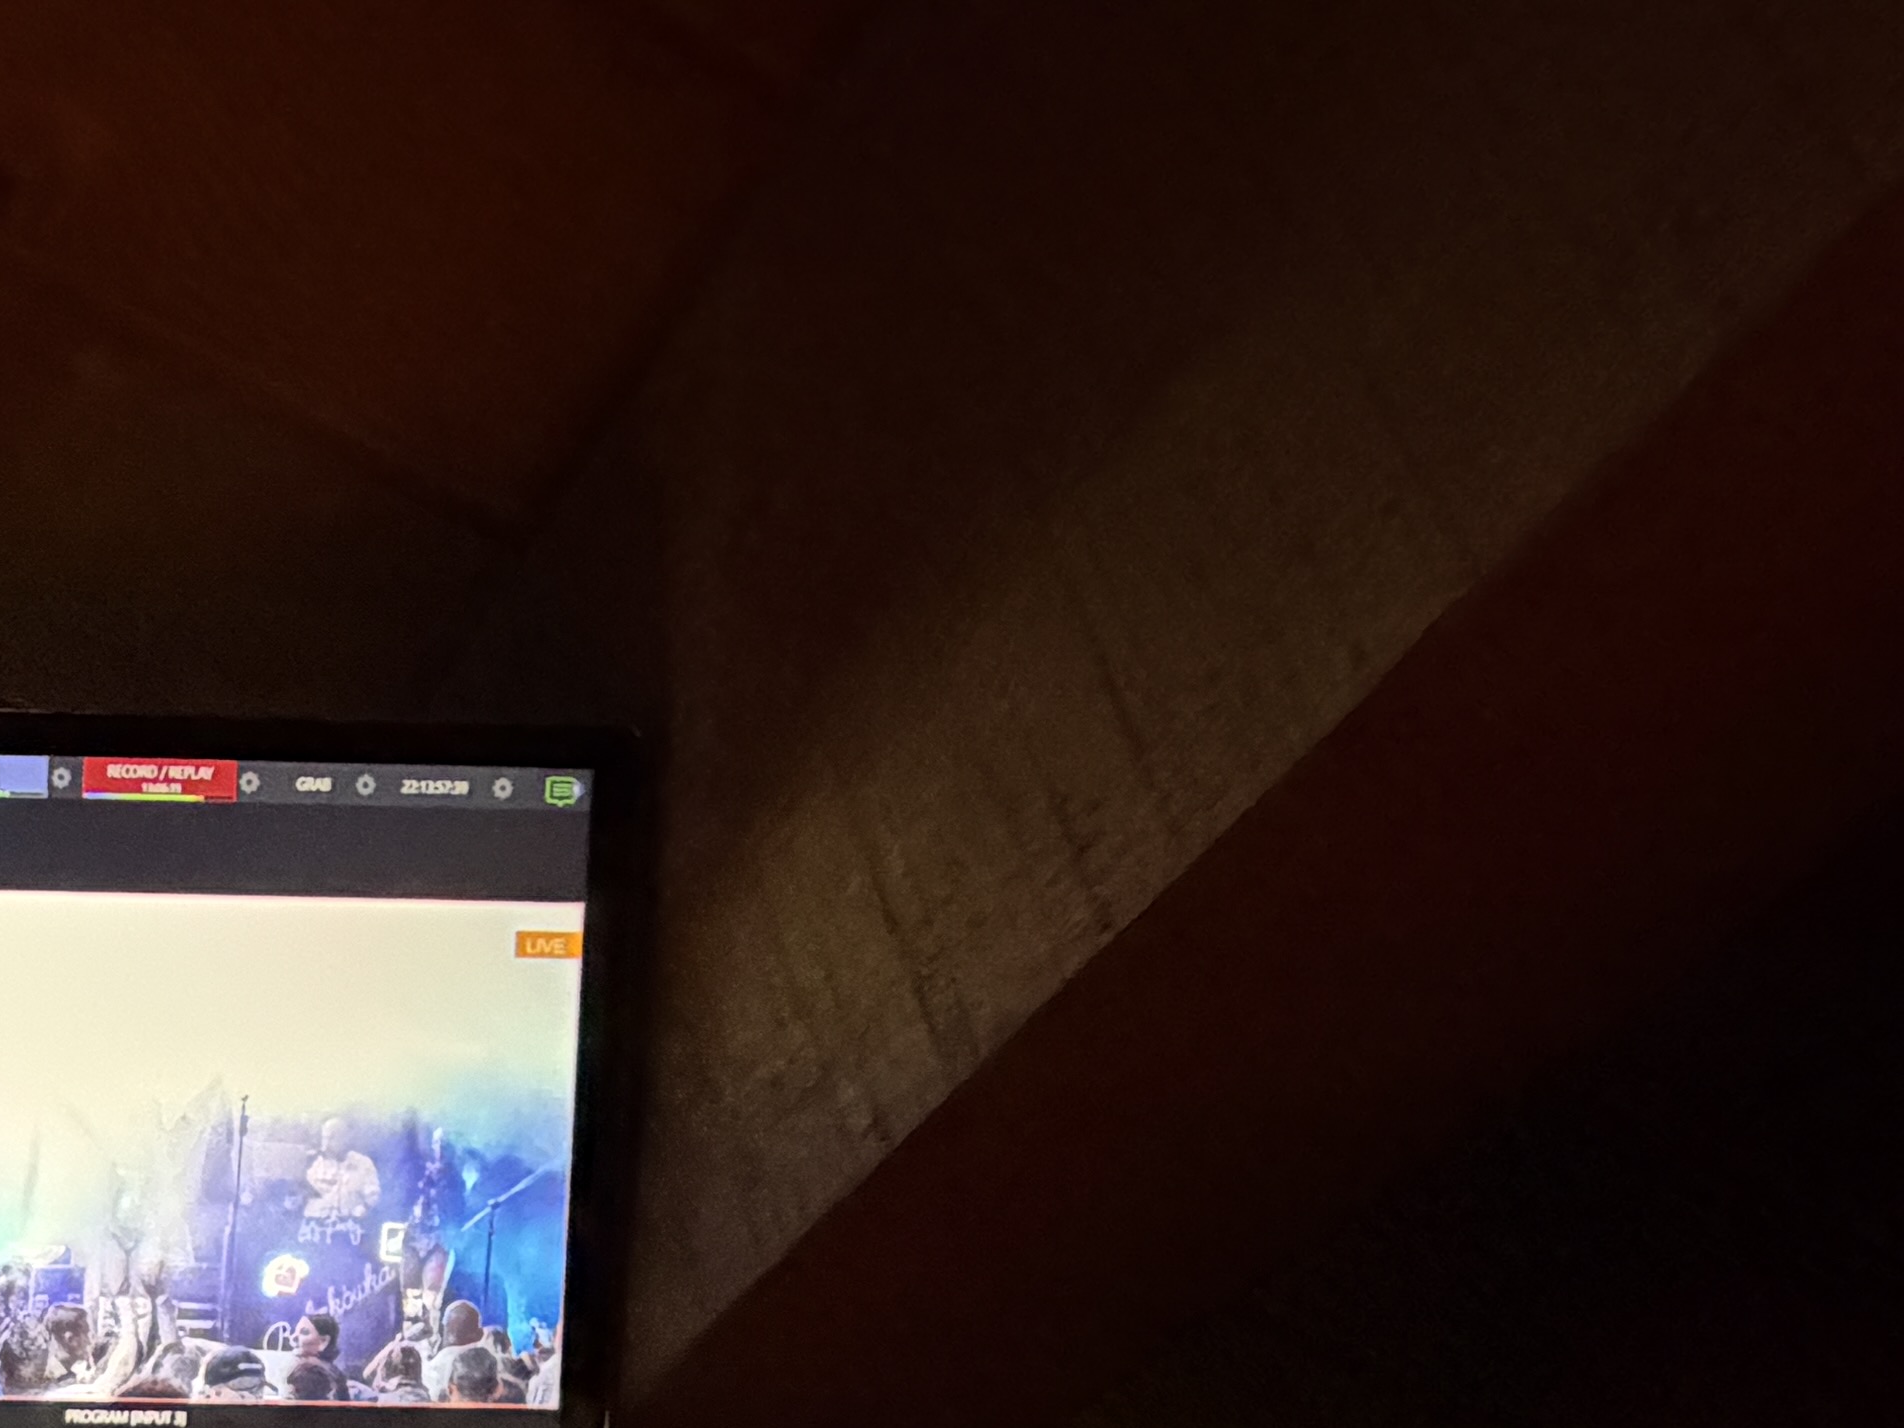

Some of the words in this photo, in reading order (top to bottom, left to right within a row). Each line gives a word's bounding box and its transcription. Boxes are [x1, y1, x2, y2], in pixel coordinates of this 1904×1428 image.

[107, 764, 157, 779] RECORD
[168, 766, 214, 781] REPLAY
[295, 776, 332, 792] GRAB
[525, 936, 567, 955] LIVE
[65, 1409, 128, 1424] PROGRAM
